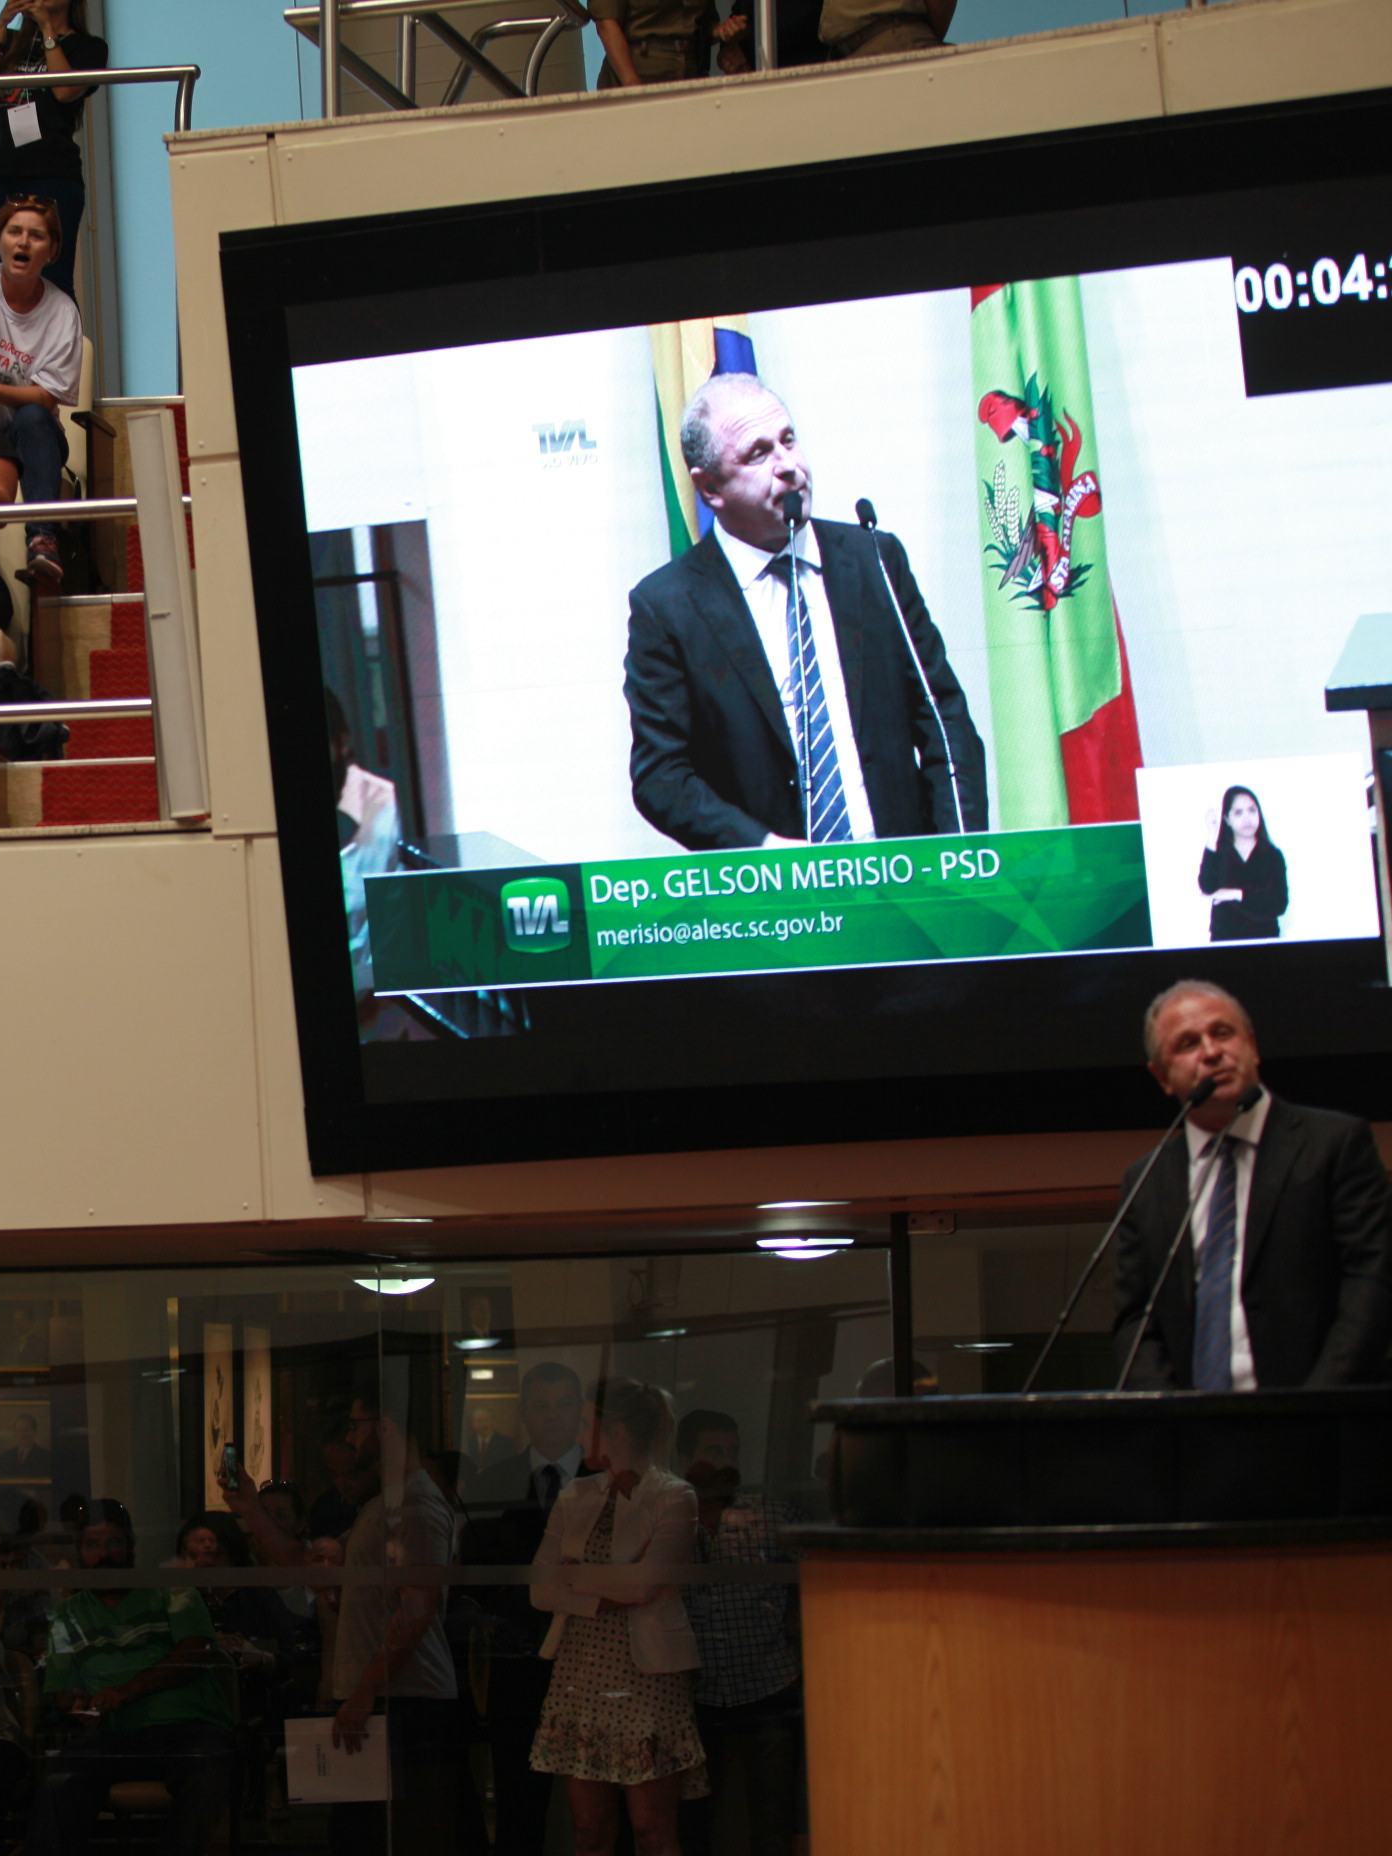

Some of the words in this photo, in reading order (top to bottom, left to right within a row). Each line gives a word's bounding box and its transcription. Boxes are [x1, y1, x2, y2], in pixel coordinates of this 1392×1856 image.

[1234, 253, 1392, 313] 00:04:
[590, 874, 657, 908] Dep.
[663, 862, 783, 898] GELSON
[791, 854, 914, 890] MERISIO
[940, 848, 1001, 880] PSD
[596, 910, 844, 947] merisio@alesc.sc.gov.br
